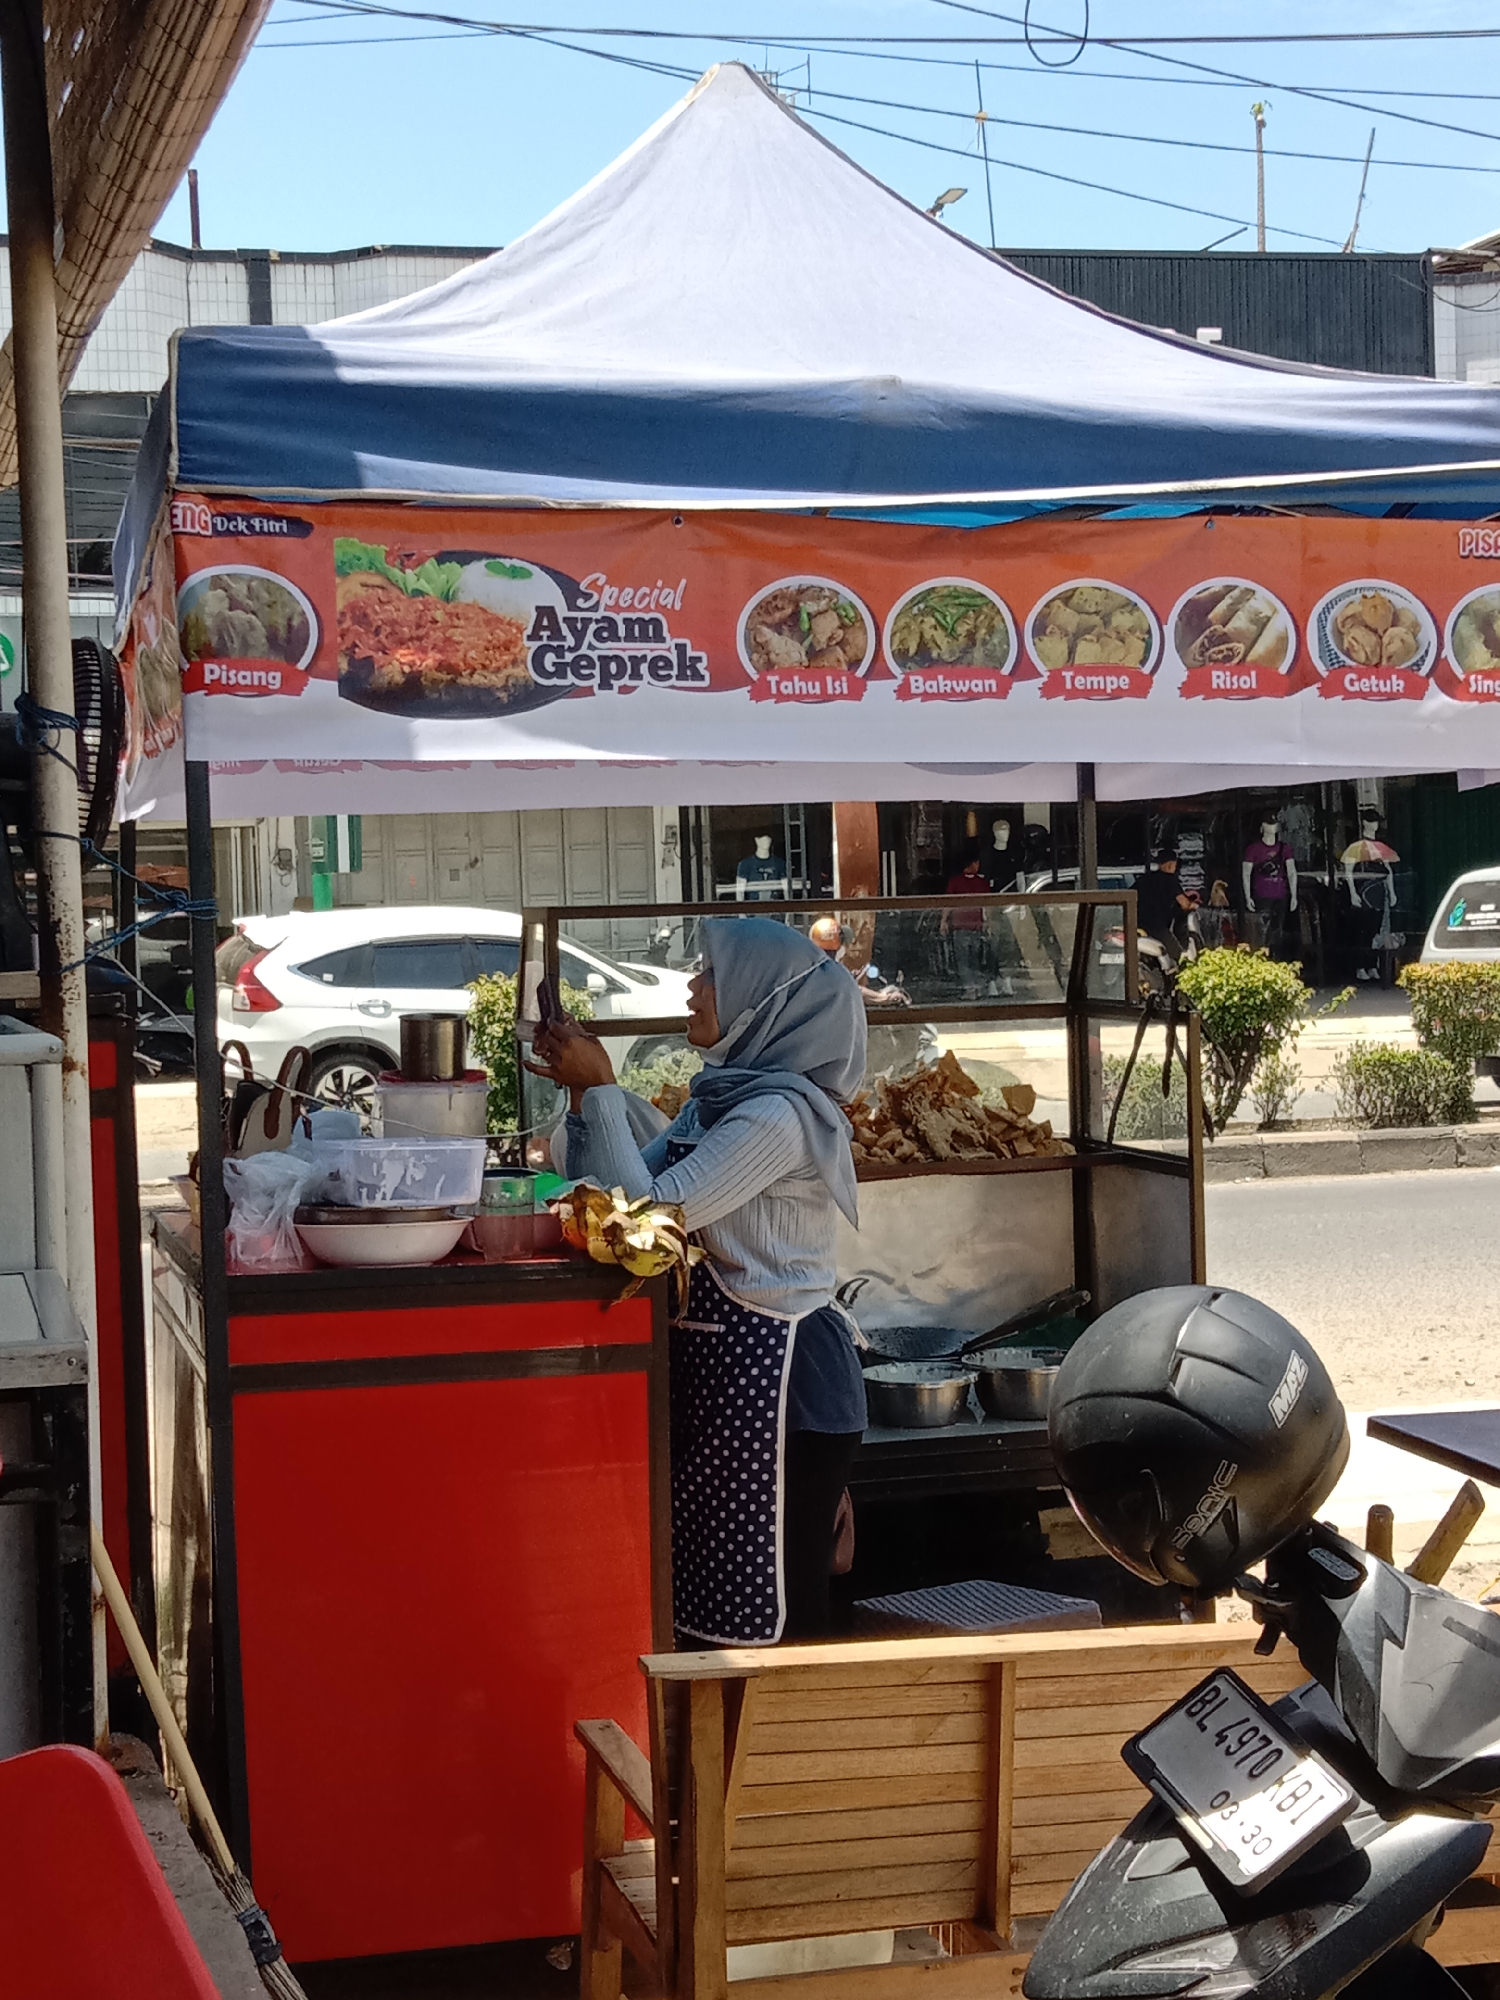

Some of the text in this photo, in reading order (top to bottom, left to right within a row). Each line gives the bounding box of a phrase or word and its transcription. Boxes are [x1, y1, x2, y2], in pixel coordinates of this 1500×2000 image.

[250, 517, 288, 533] Fitri
[576, 572, 687, 611] Special
[526, 605, 667, 653] Ayam
[203, 663, 282, 690] Pisang
[531, 643, 705, 690] Geprek
[766, 675, 848, 695] Tahu Isi
[909, 674, 997, 694] Bakwan
[1062, 671, 1130, 693] Tempe
[1211, 670, 1257, 689] Risol
[1344, 673, 1405, 693] Getuk
[1269, 1352, 1308, 1427] MAZ
[1185, 1685, 1325, 1826] BL 4970 KBI
